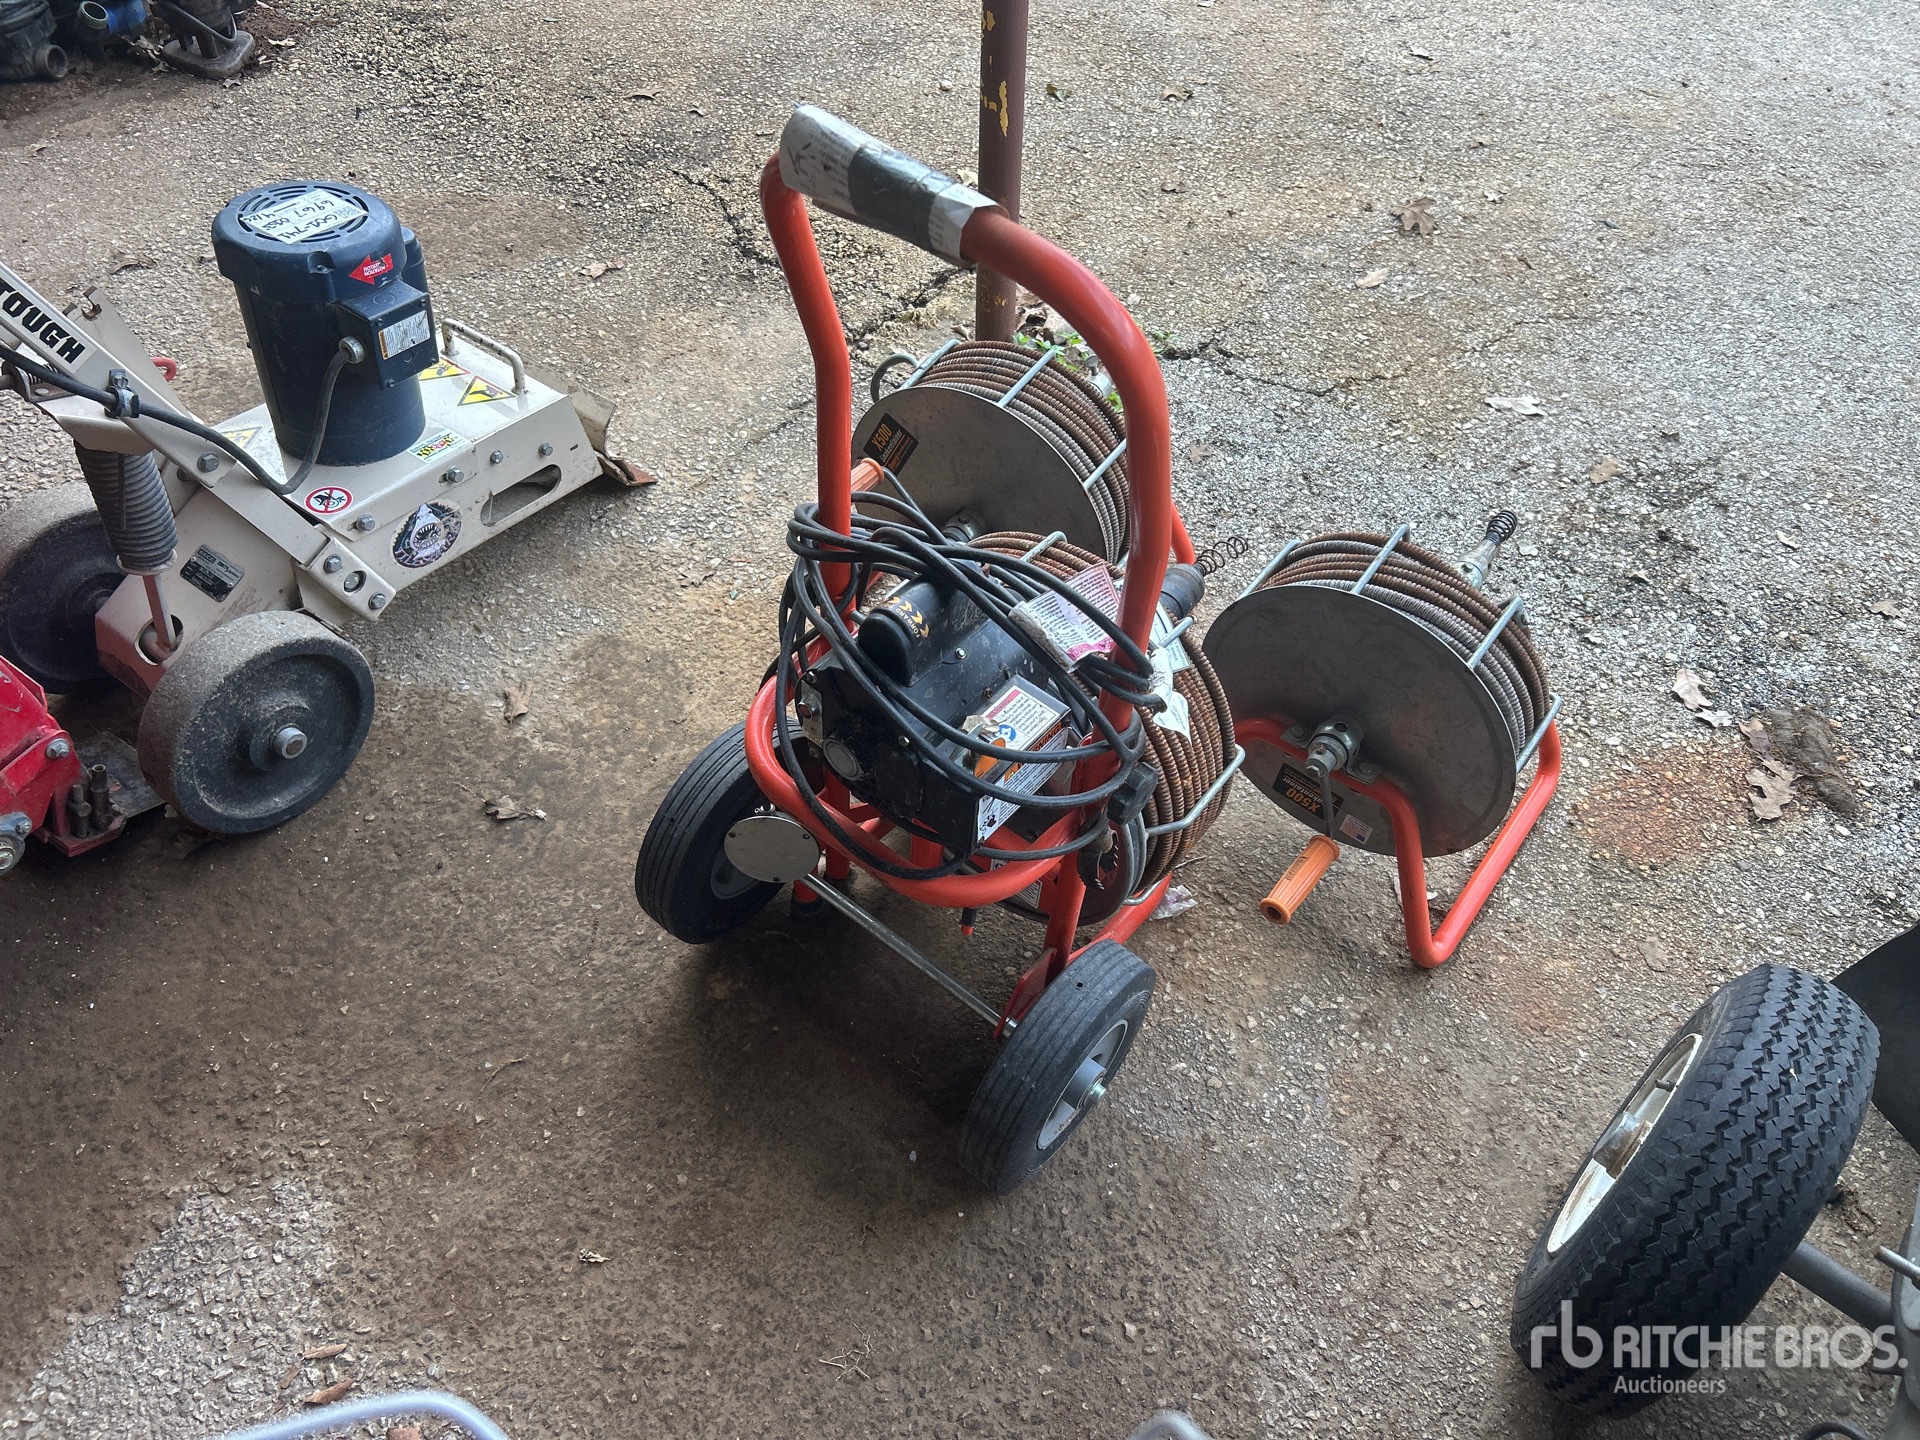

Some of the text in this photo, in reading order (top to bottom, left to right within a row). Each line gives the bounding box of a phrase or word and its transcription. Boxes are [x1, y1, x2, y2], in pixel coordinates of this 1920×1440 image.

[0, 278, 86, 364] TOUGH
[871, 423, 893, 451] X500
[895, 608, 921, 639] FORWARD
[1285, 787, 1321, 813] X500
